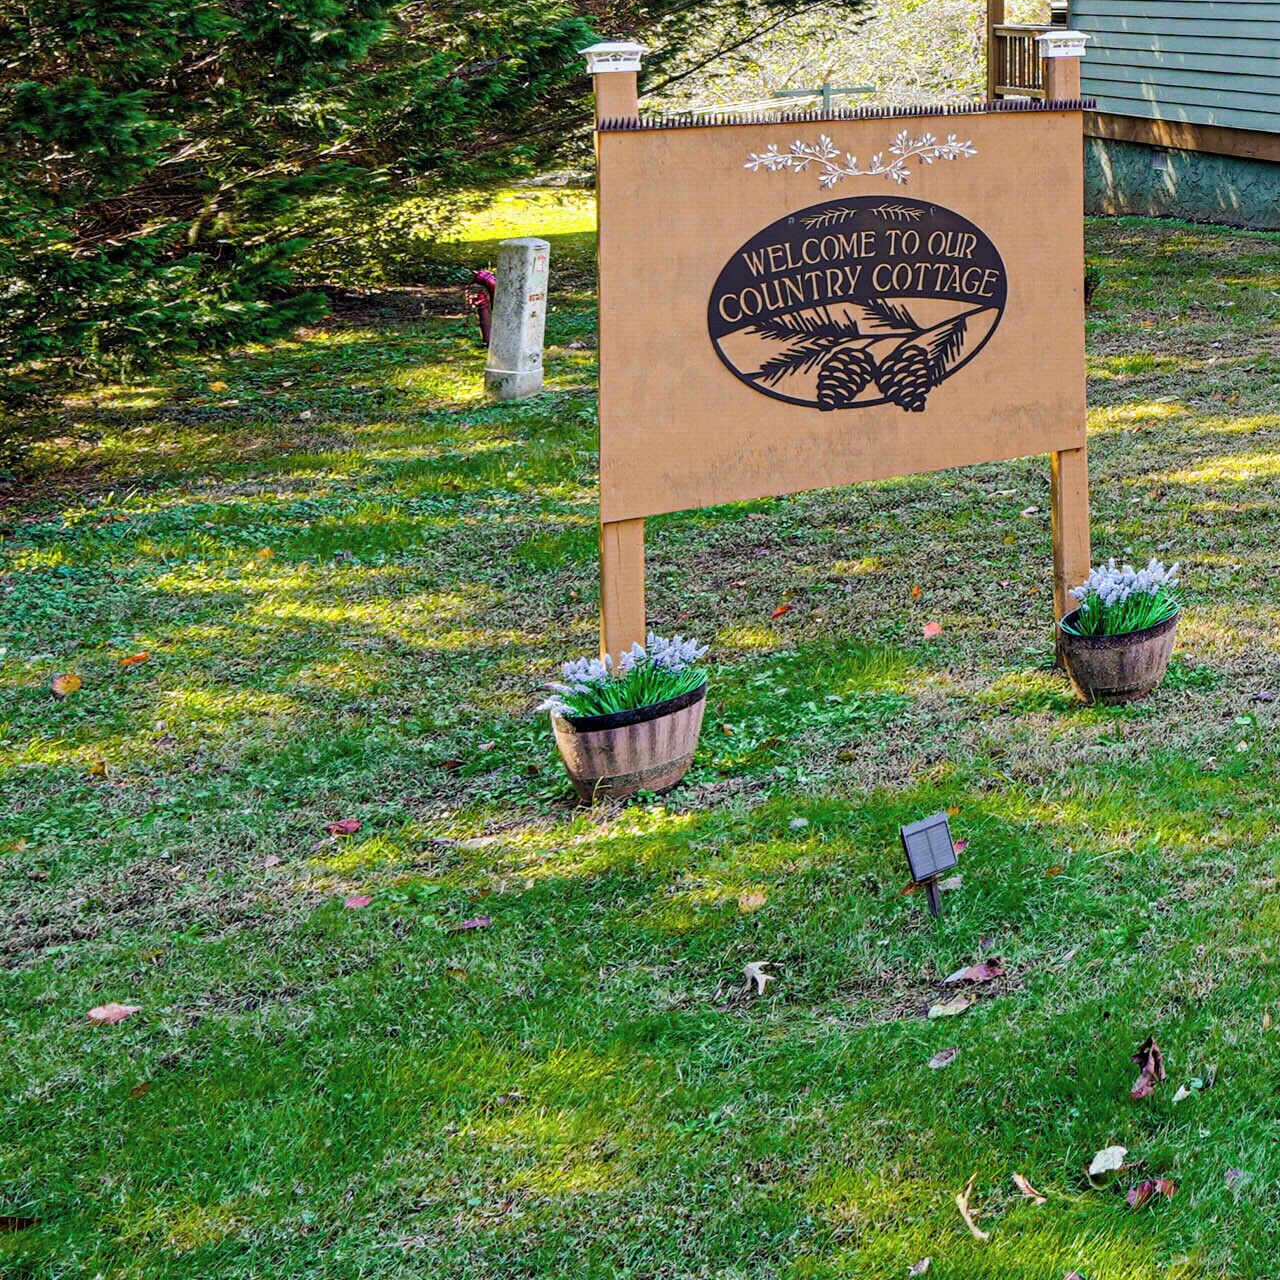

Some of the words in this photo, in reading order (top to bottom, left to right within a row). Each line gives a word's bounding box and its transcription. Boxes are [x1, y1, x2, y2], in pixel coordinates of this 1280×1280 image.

[742, 230, 877, 277] WELCOME
[885, 230, 921, 256] TO
[928, 231, 978, 259] OUR
[718, 265, 862, 322] COUNTRY
[872, 263, 1000, 298] COTTAGE
